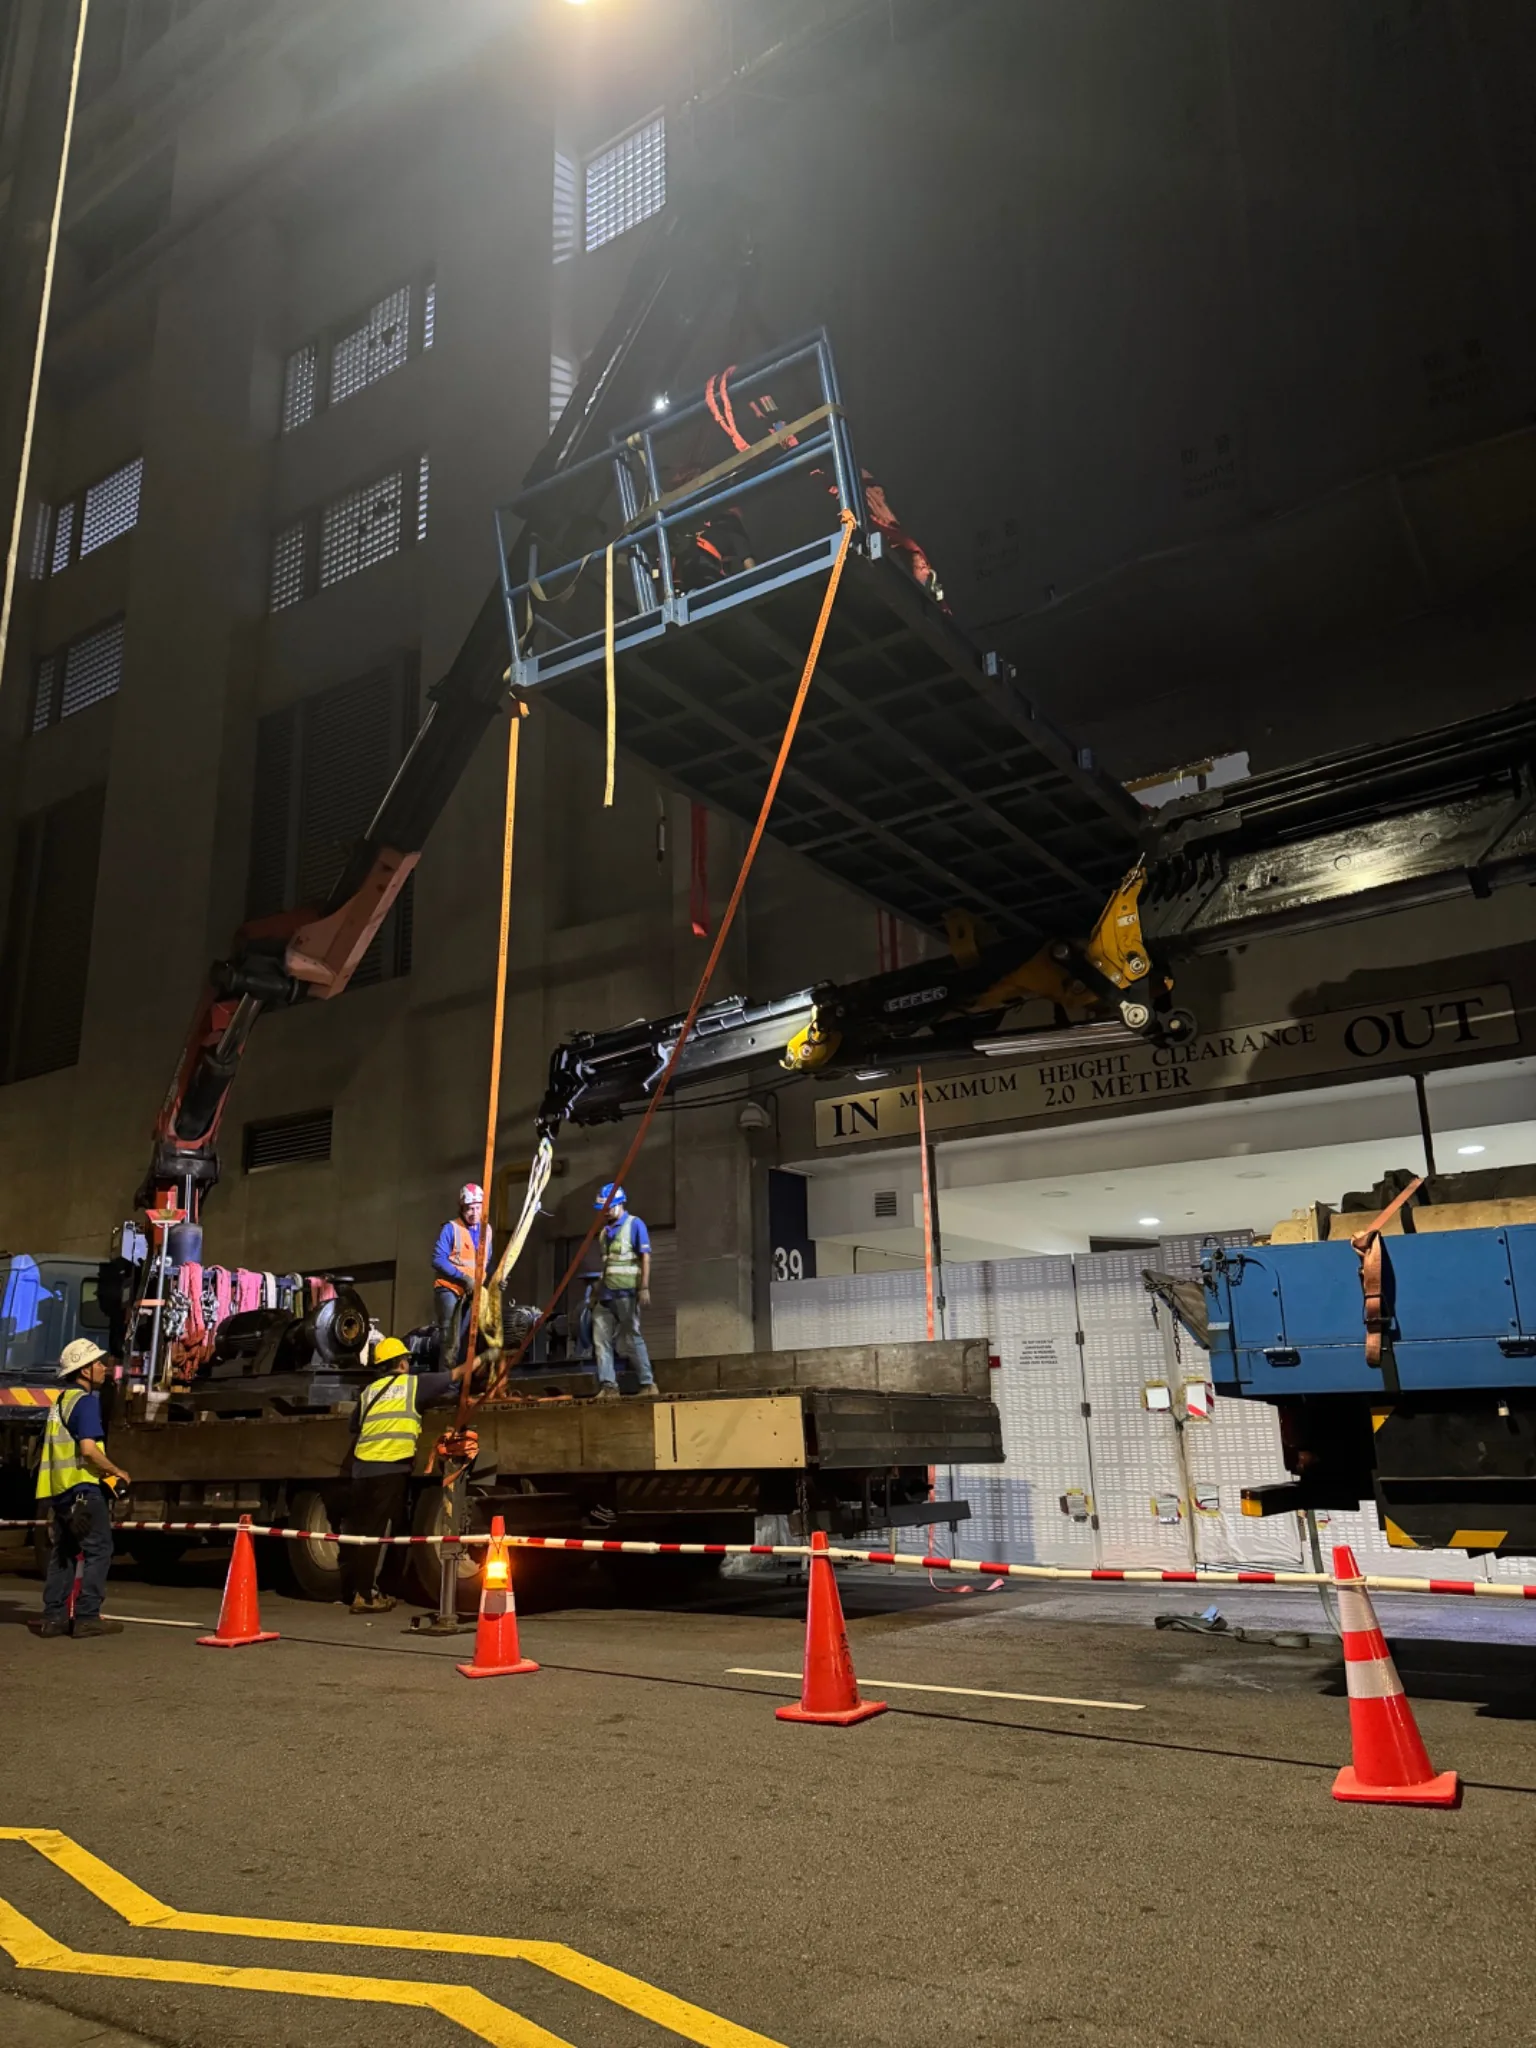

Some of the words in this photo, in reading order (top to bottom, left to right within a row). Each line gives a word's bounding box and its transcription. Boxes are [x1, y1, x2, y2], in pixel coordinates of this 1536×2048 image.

[1344, 997, 1484, 1057] OUT
[900, 1073, 1017, 1108] MAXIMUM
[1039, 1054, 1131, 1085] HEIGHT
[1152, 1023, 1317, 1067] CLEARANCE
[1045, 1084, 1075, 1107] 2.0
[1092, 1066, 1192, 1100] METER
[831, 1097, 880, 1138] IN
[774, 1246, 803, 1281] 39
